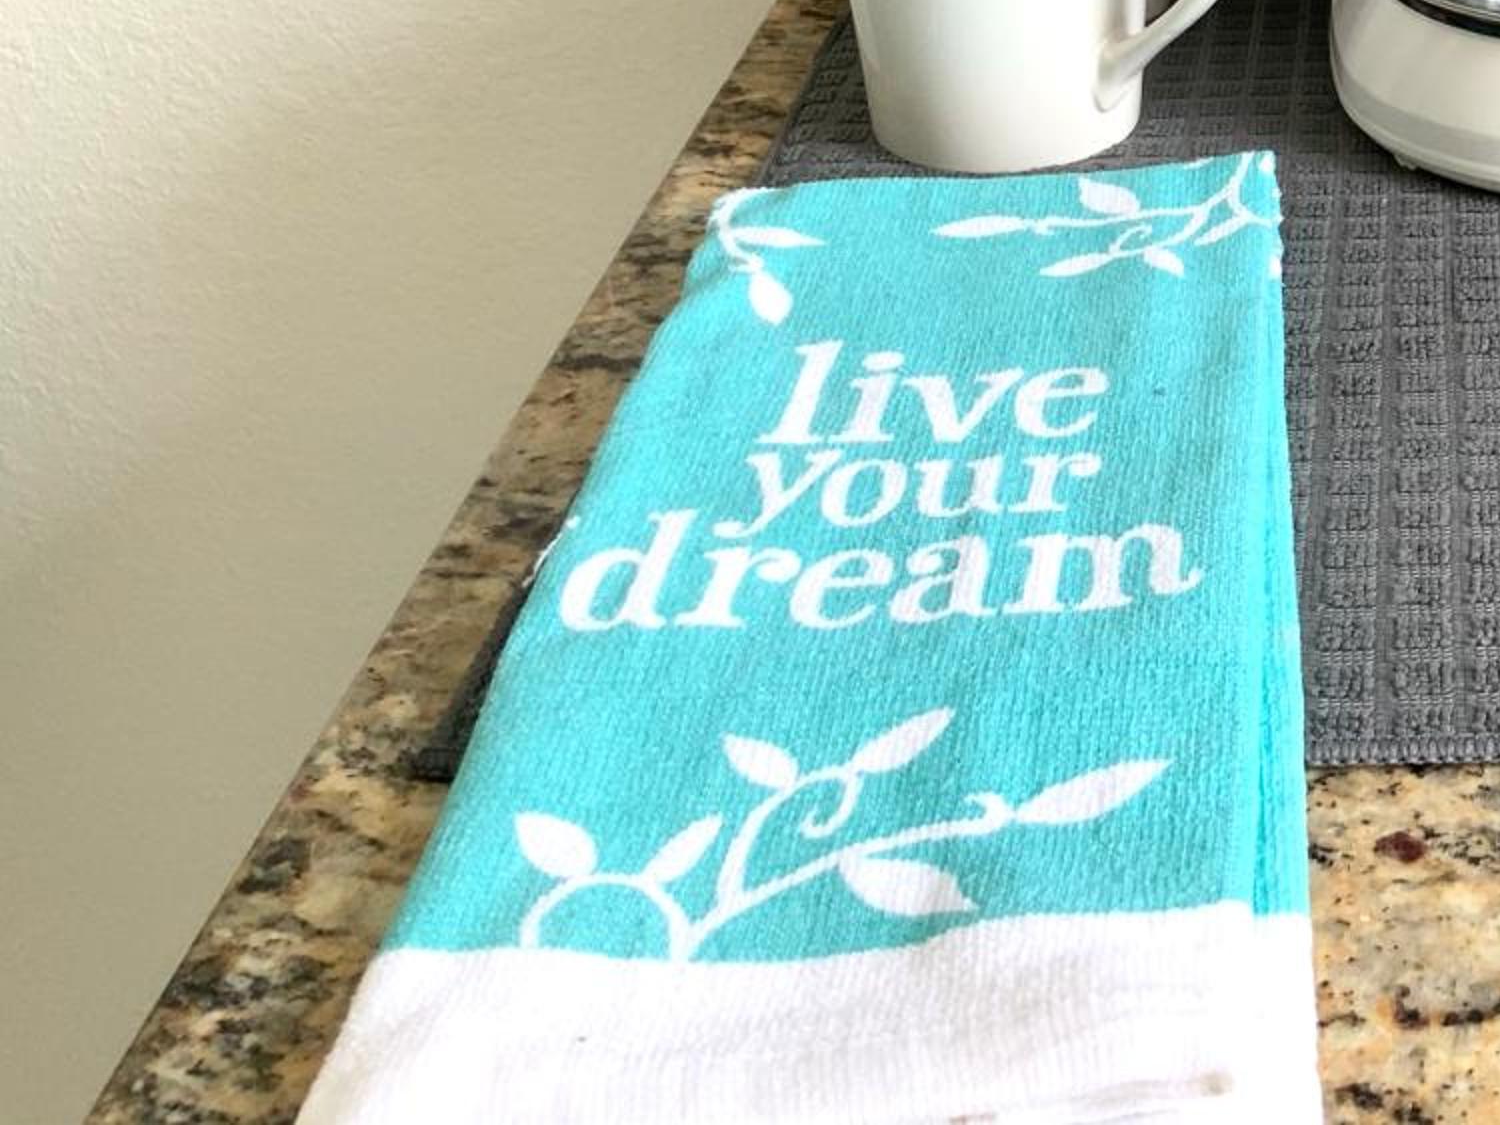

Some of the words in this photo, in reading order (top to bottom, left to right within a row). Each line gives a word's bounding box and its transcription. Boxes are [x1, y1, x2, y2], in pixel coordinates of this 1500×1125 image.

[753, 339, 1110, 446] live
[711, 445, 1103, 539] your
[559, 508, 1203, 632] dream
